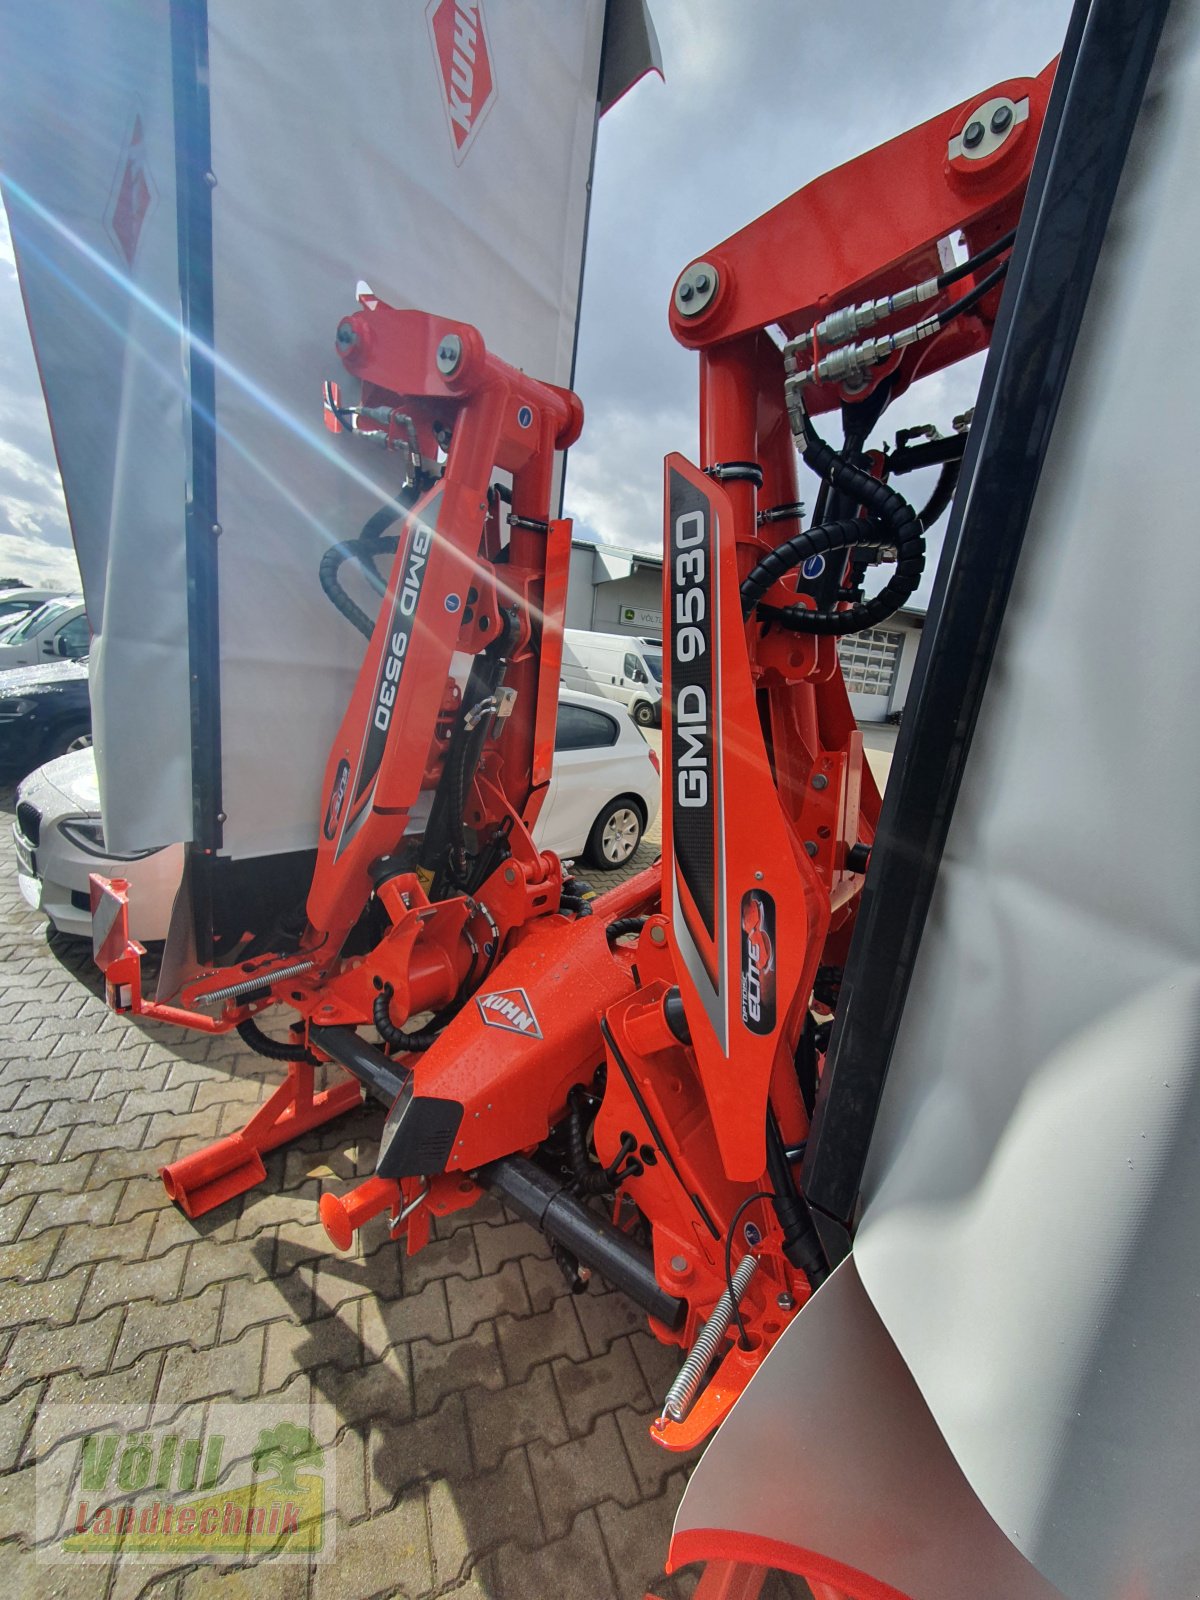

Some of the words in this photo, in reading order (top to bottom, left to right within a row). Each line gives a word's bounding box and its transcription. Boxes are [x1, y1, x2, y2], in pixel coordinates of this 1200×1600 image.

[400, 525, 432, 616] GMD
[675, 510, 706, 663] 9530
[374, 632, 408, 731] 9530
[677, 685, 708, 808] GMD
[482, 994, 534, 1031] KUHN
[748, 938, 761, 1023] ELITE
